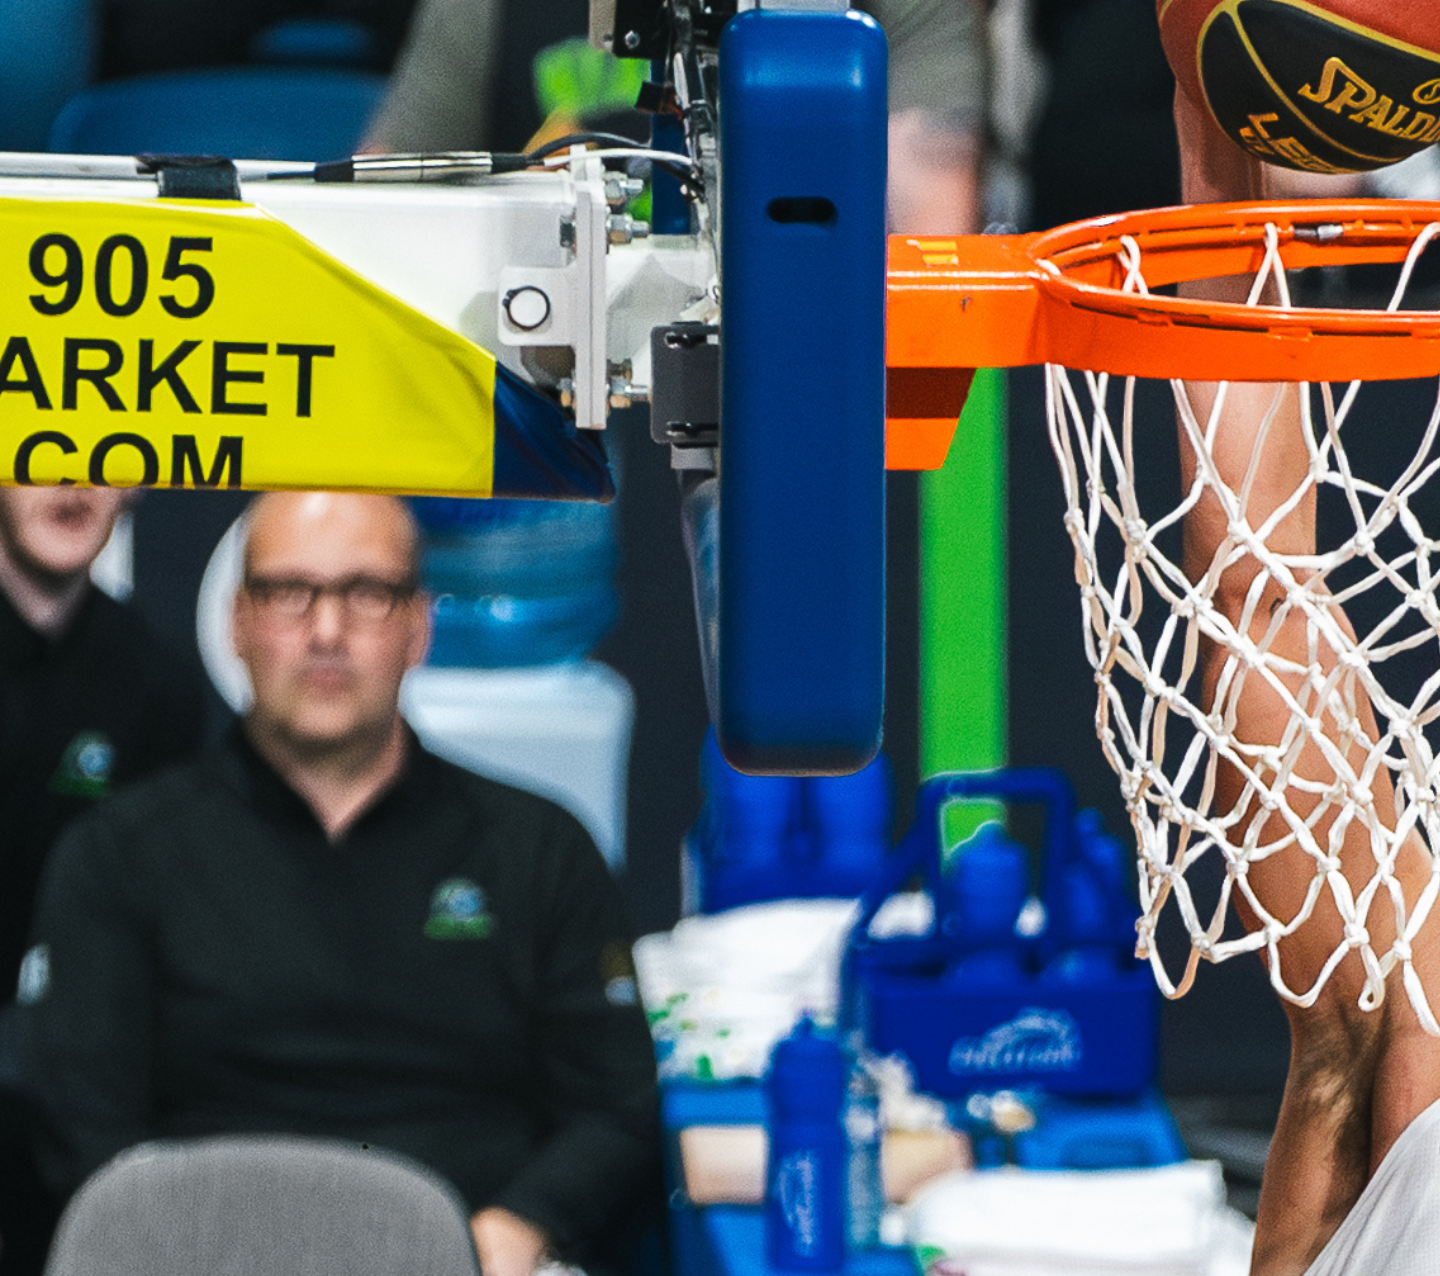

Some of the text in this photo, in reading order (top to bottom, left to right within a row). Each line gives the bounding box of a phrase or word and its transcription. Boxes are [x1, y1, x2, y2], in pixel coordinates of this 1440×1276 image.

[28, 233, 215, 318] 905
[0, 336, 335, 417] ARKET
[13, 430, 244, 489] COM
